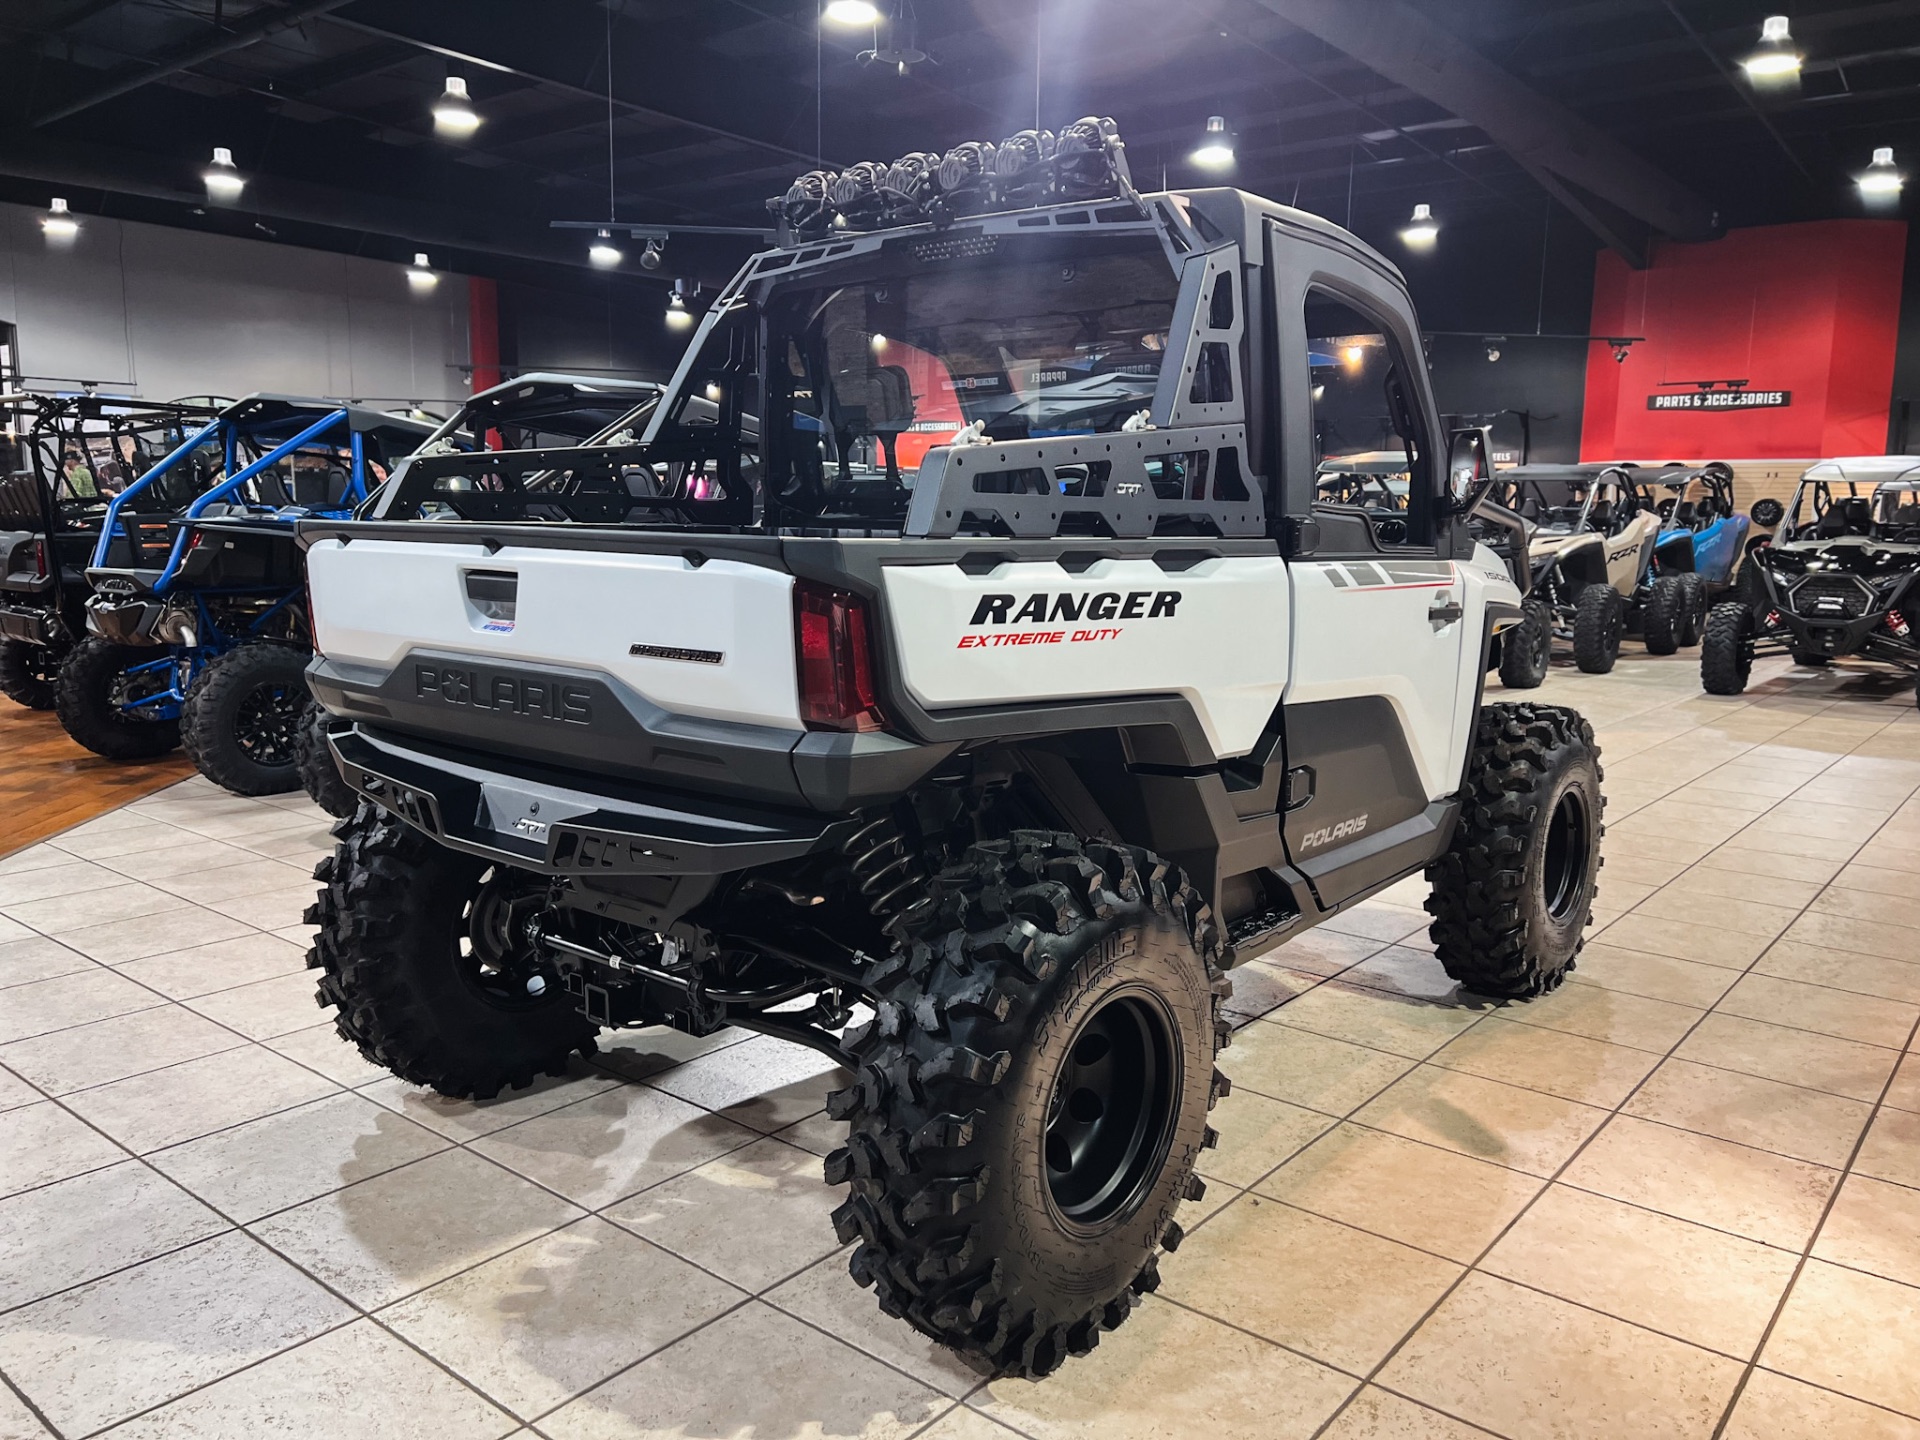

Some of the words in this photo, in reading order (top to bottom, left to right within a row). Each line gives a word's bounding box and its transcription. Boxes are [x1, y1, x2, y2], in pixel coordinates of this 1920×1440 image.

[1656, 394, 1691, 408] PARTS
[920, 421, 957, 431] ACCESSORIES
[1607, 543, 1639, 565] RZR
[1694, 533, 1722, 557] RZR
[968, 590, 1182, 625] RANGER
[956, 631, 1066, 648] EXTREME
[1070, 628, 1124, 642] DUTY
[415, 664, 593, 725] POLARIS
[1299, 813, 1369, 852] POLARIS
